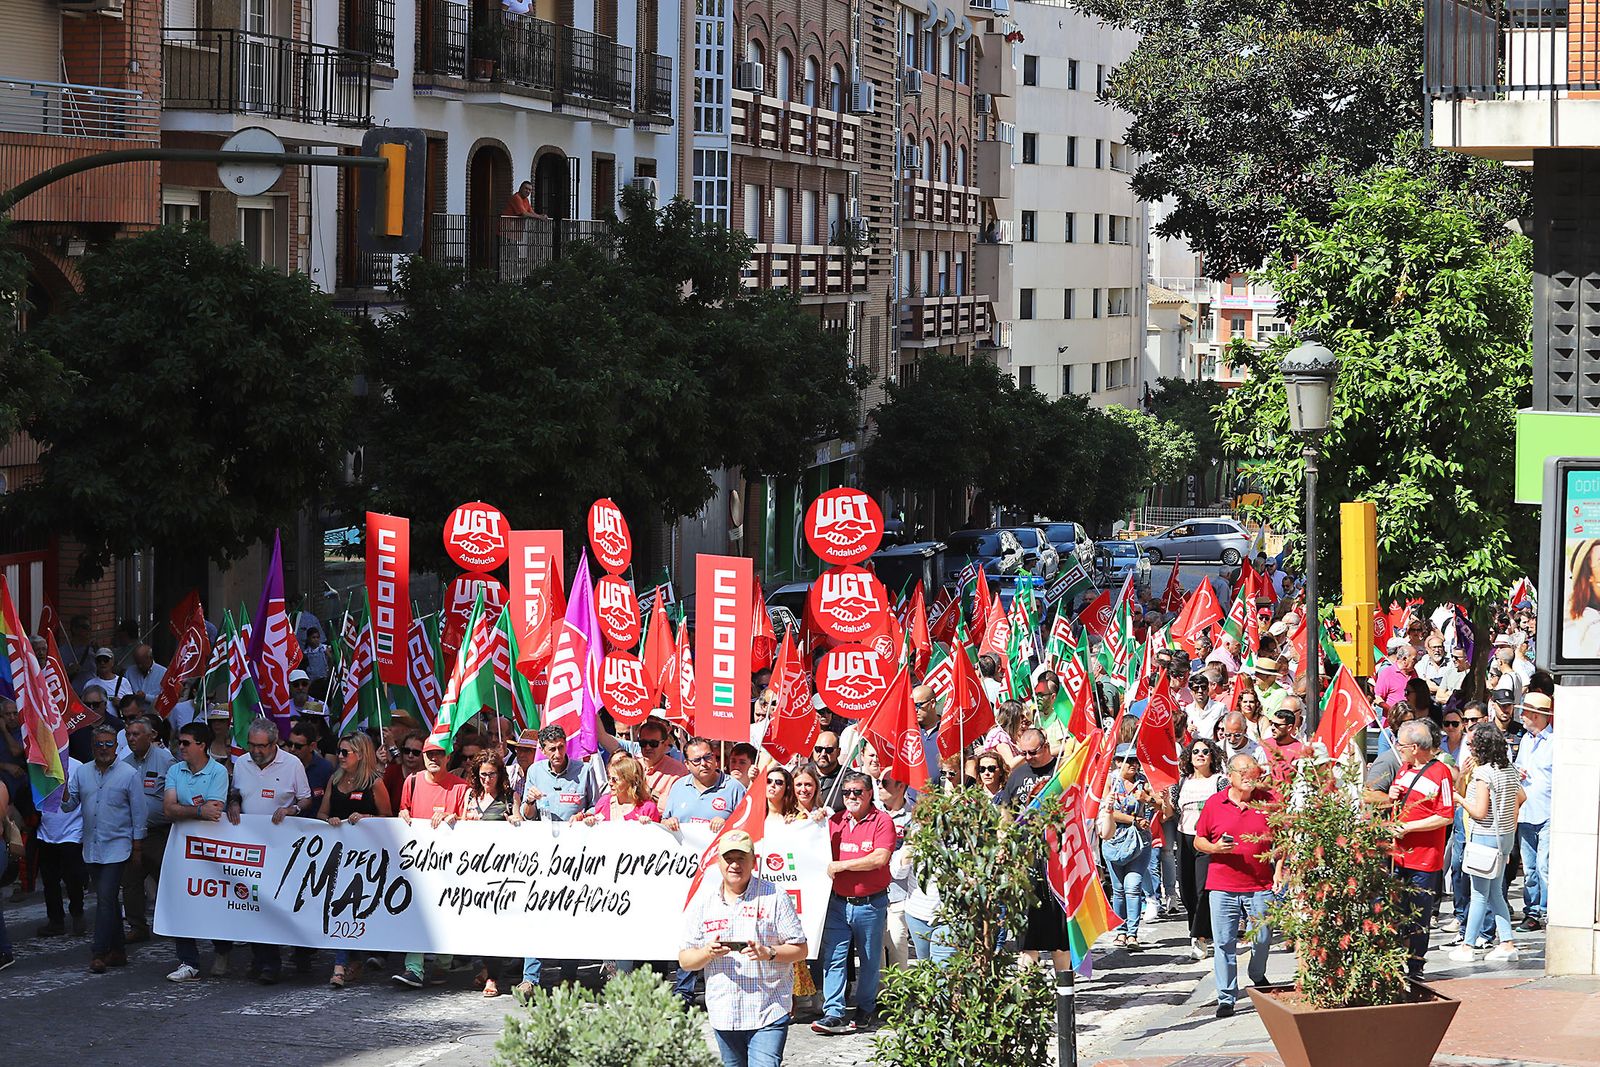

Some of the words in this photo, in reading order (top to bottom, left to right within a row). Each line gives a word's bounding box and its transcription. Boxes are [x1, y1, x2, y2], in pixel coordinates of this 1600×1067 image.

[594, 505, 623, 534] UGT
[816, 494, 871, 526] UGT
[453, 508, 501, 539] UGT
[459, 553, 496, 566] Andalucía
[601, 553, 625, 566] Andalucía
[826, 542, 868, 557] Andalucía
[454, 579, 501, 605] UGT
[600, 580, 632, 612] UGT
[821, 573, 874, 600] UGT
[607, 628, 633, 641] Andalucía
[830, 621, 872, 633] Andalucía
[605, 656, 644, 688] UGT
[826, 650, 880, 681] UGT
[612, 704, 643, 717] Andalucía
[712, 710, 734, 719] HUELVA
[836, 698, 878, 711] Andalucía
[343, 849, 370, 869] DE
[399, 840, 453, 871] Subir
[547, 844, 606, 882] bajar
[614, 849, 700, 883] precios
[223, 864, 262, 879] Huelva
[761, 872, 798, 882] Huelva
[187, 877, 231, 898] UGT
[293, 841, 413, 935] MAYO
[438, 878, 526, 915] repartir
[524, 880, 632, 917] beneficios
[227, 900, 260, 912] Huelva
[330, 921, 366, 939] 2023
